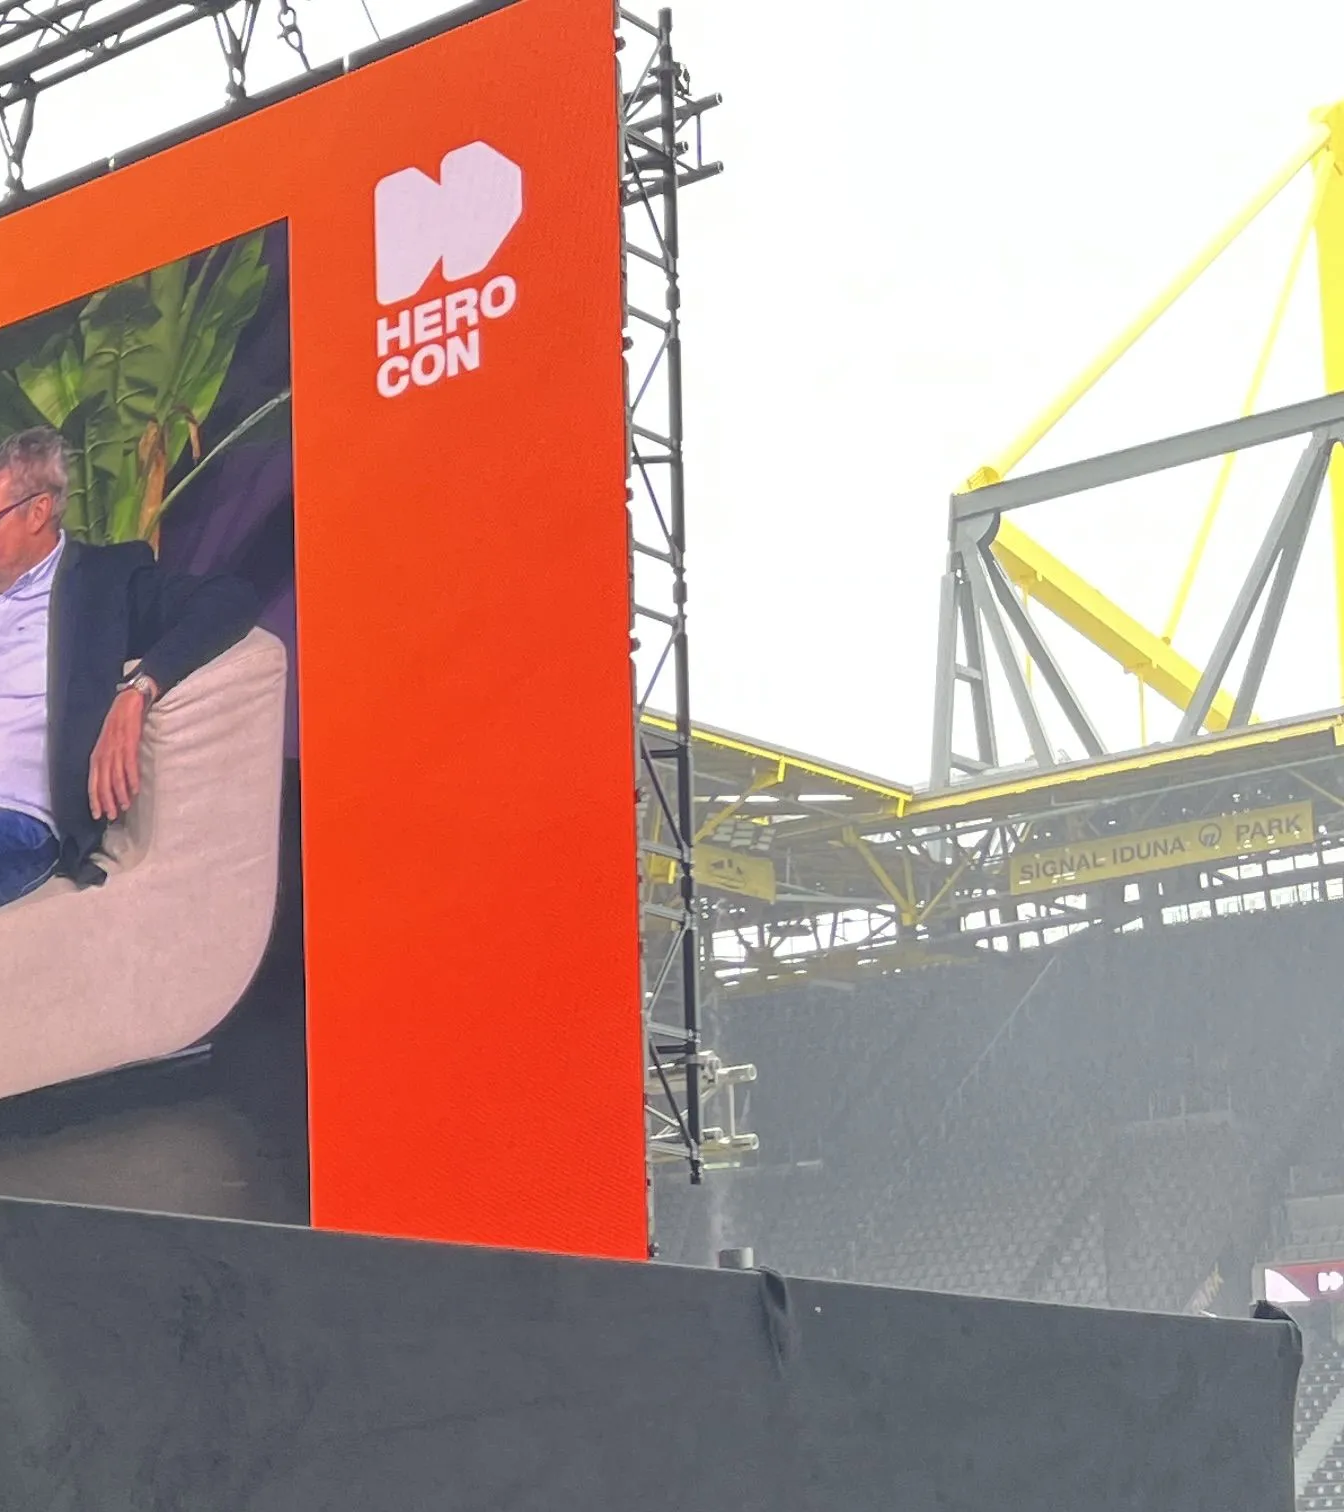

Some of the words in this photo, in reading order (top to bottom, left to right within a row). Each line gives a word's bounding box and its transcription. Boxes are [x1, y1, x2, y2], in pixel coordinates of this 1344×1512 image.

[376, 275, 517, 358] HERO
[376, 328, 480, 398] CON
[1020, 857, 1105, 882] SIGNAL
[1112, 837, 1186, 865] IDUNA
[1235, 814, 1302, 843] PARK
